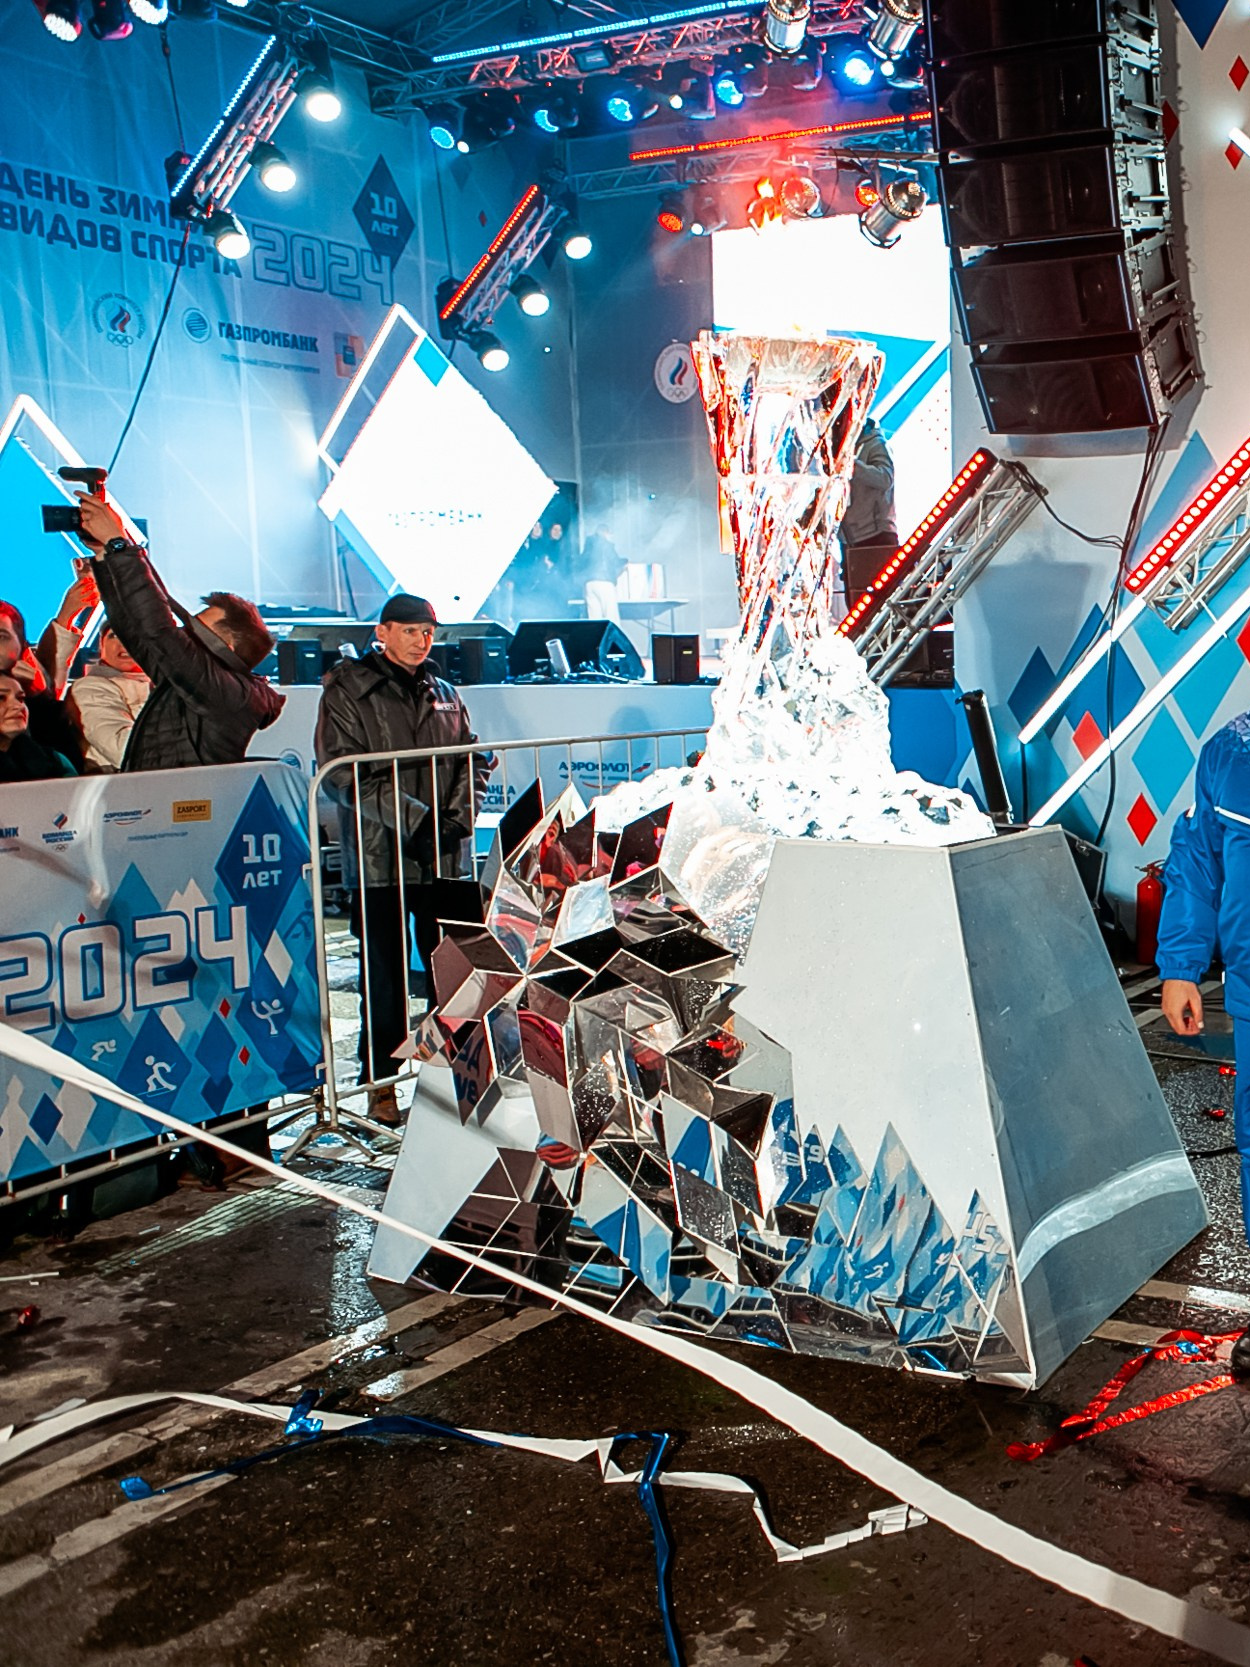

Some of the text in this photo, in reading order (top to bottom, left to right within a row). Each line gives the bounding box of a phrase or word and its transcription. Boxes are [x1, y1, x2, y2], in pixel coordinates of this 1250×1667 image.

[0, 162, 203, 233] ДЕНЬ ЗИМ
[370, 191, 397, 219] 10
[0, 201, 122, 253] ВИДОВ
[252, 223, 395, 306] 2024
[218, 321, 319, 353] ГАЗПРОМБАНК
[242, 833, 281, 864] 10
[0, 905, 252, 1033] 2024
